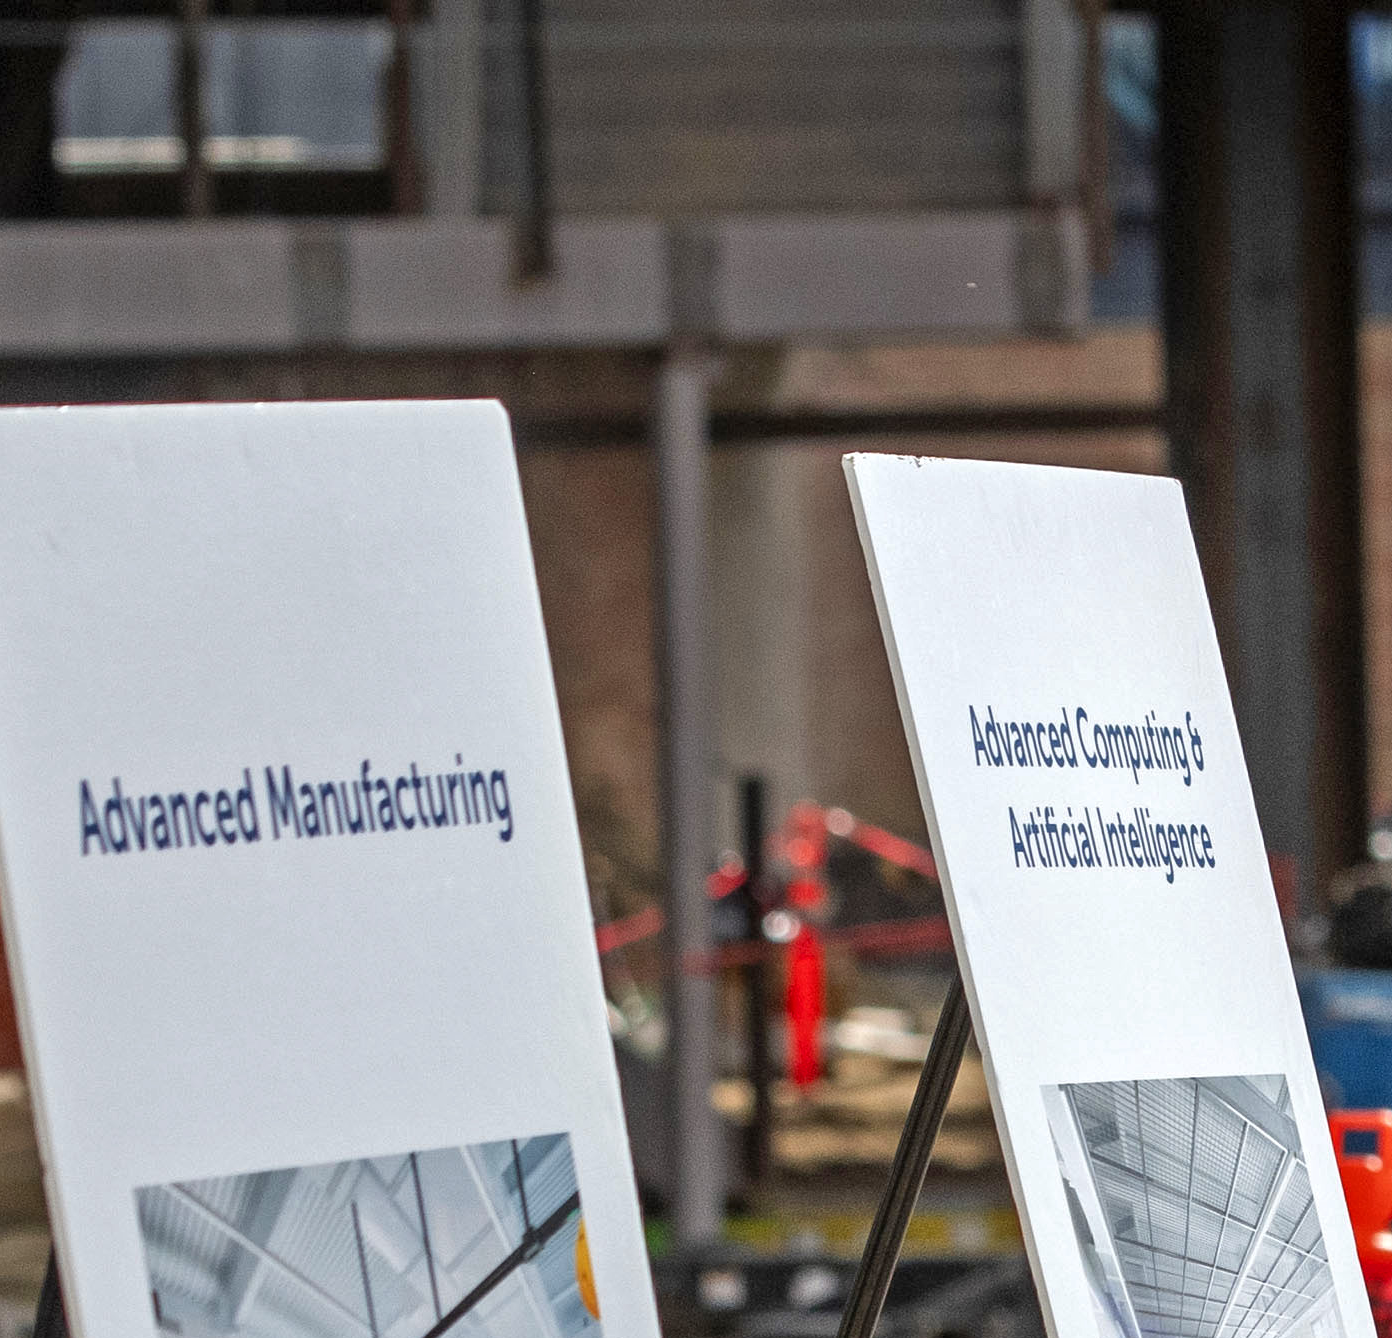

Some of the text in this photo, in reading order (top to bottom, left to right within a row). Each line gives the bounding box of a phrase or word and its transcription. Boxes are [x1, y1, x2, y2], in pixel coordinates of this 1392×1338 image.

[968, 704, 1205, 787] Advanced Computing &
[78, 752, 514, 857] Advanced Manufacturing
[1008, 806, 1216, 884] Artificial Intelligence
